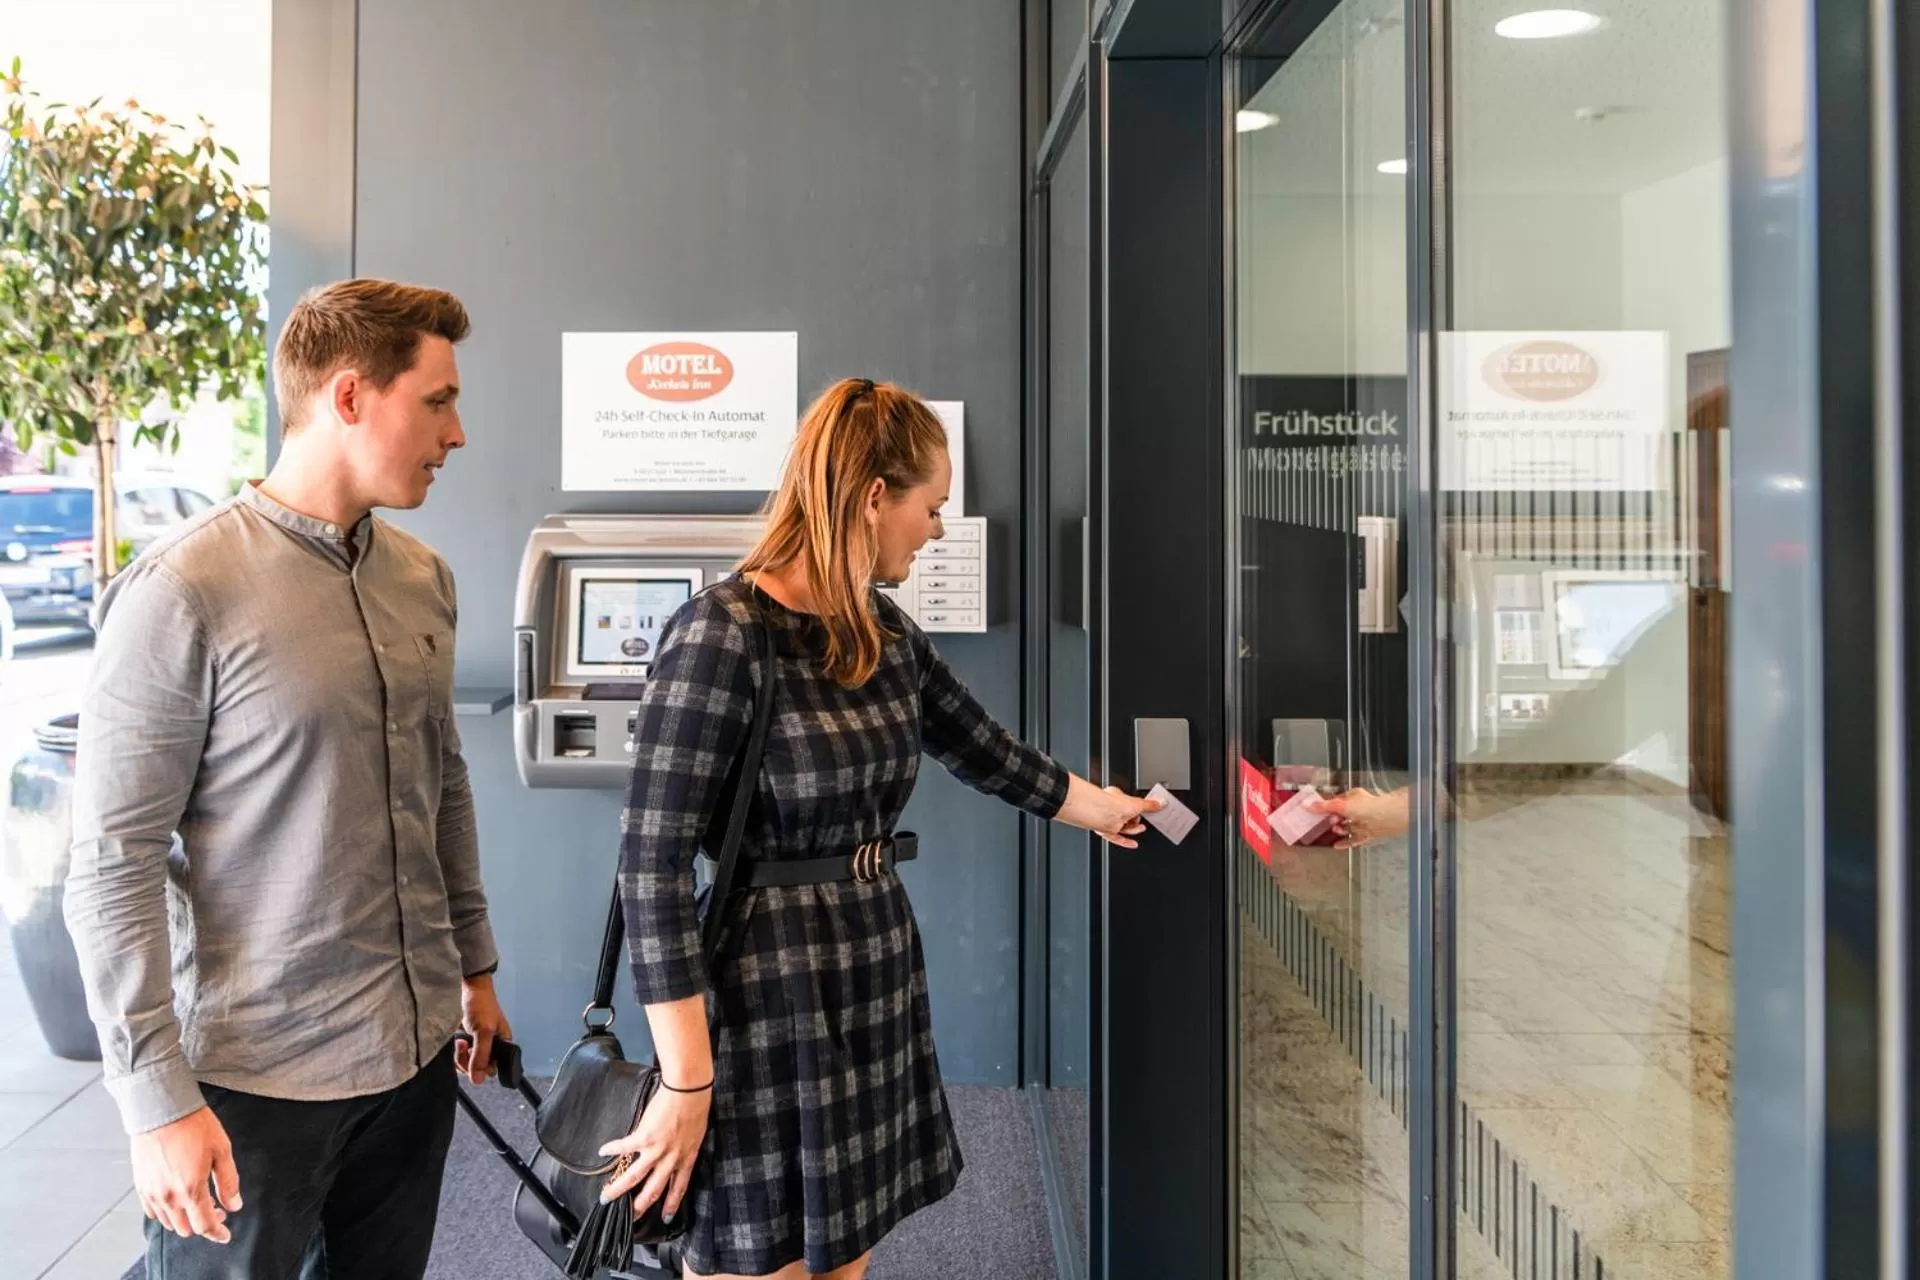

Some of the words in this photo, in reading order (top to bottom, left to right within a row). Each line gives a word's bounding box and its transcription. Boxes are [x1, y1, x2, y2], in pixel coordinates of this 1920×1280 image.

[641, 354, 723, 375] MOTEL
[595, 410, 618, 422] 24h
[708, 410, 766, 422] Automat
[1254, 409, 1399, 436] Frühstück
[602, 429, 639, 440] Parken
[640, 429, 665, 440] bitte
[668, 429, 679, 440] in
[680, 429, 698, 440] der
[701, 429, 758, 442] Tiefgarage
